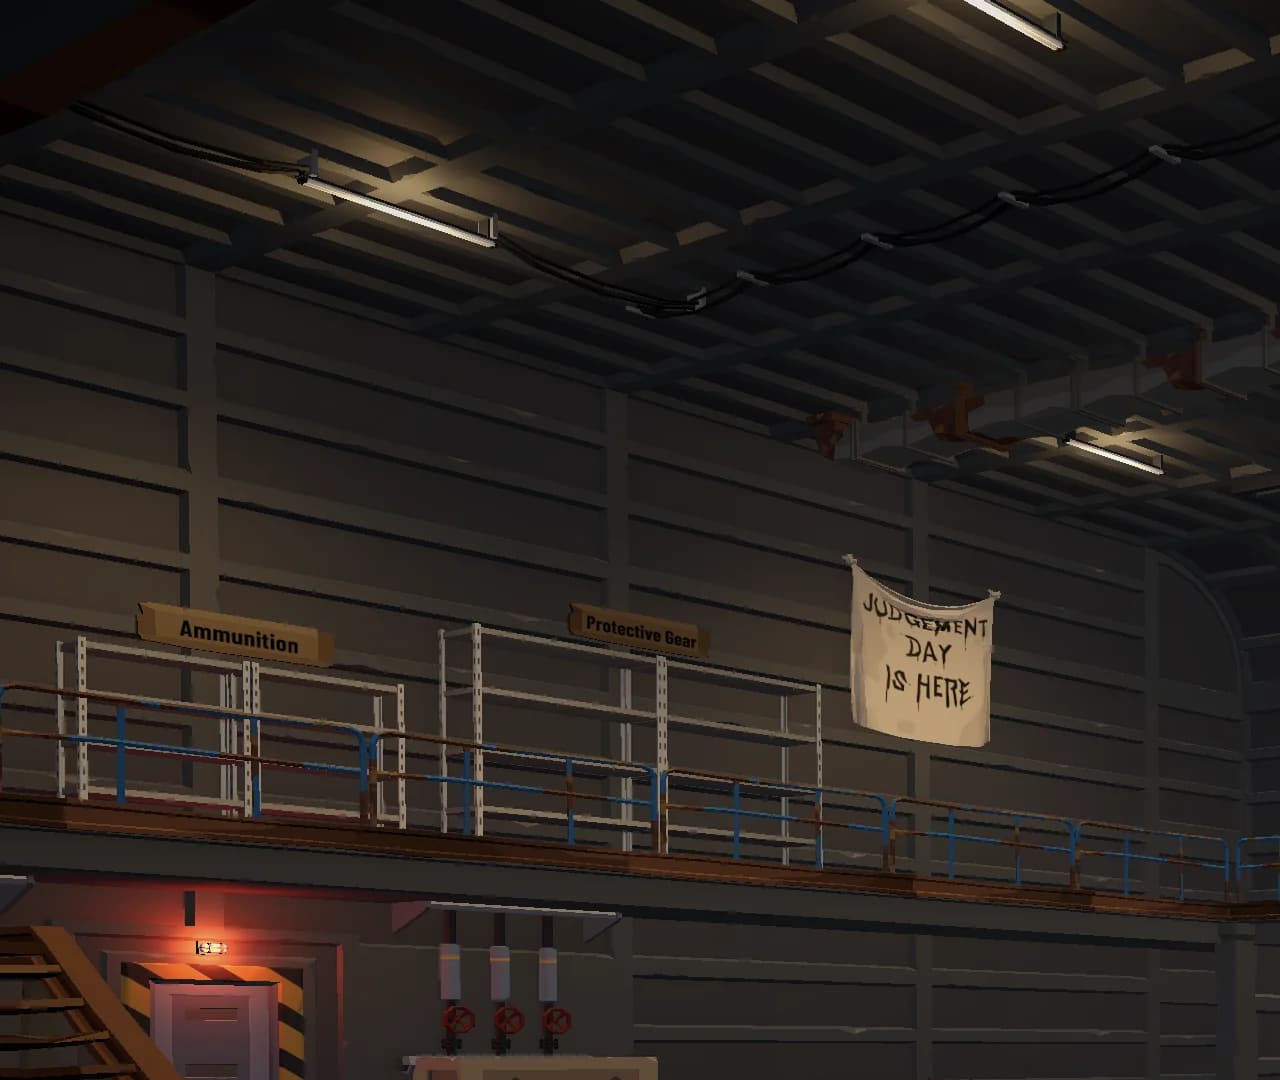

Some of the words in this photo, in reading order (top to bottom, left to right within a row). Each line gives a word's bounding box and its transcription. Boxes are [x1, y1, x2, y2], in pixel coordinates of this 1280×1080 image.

[586, 616, 661, 642] Protective
[665, 631, 696, 648] Gear
[863, 593, 988, 641] JUDGEMENT
[180, 620, 298, 654] Ammunition
[905, 635, 952, 668] DAY
[885, 664, 908, 703] IS
[917, 673, 973, 710] HERE
